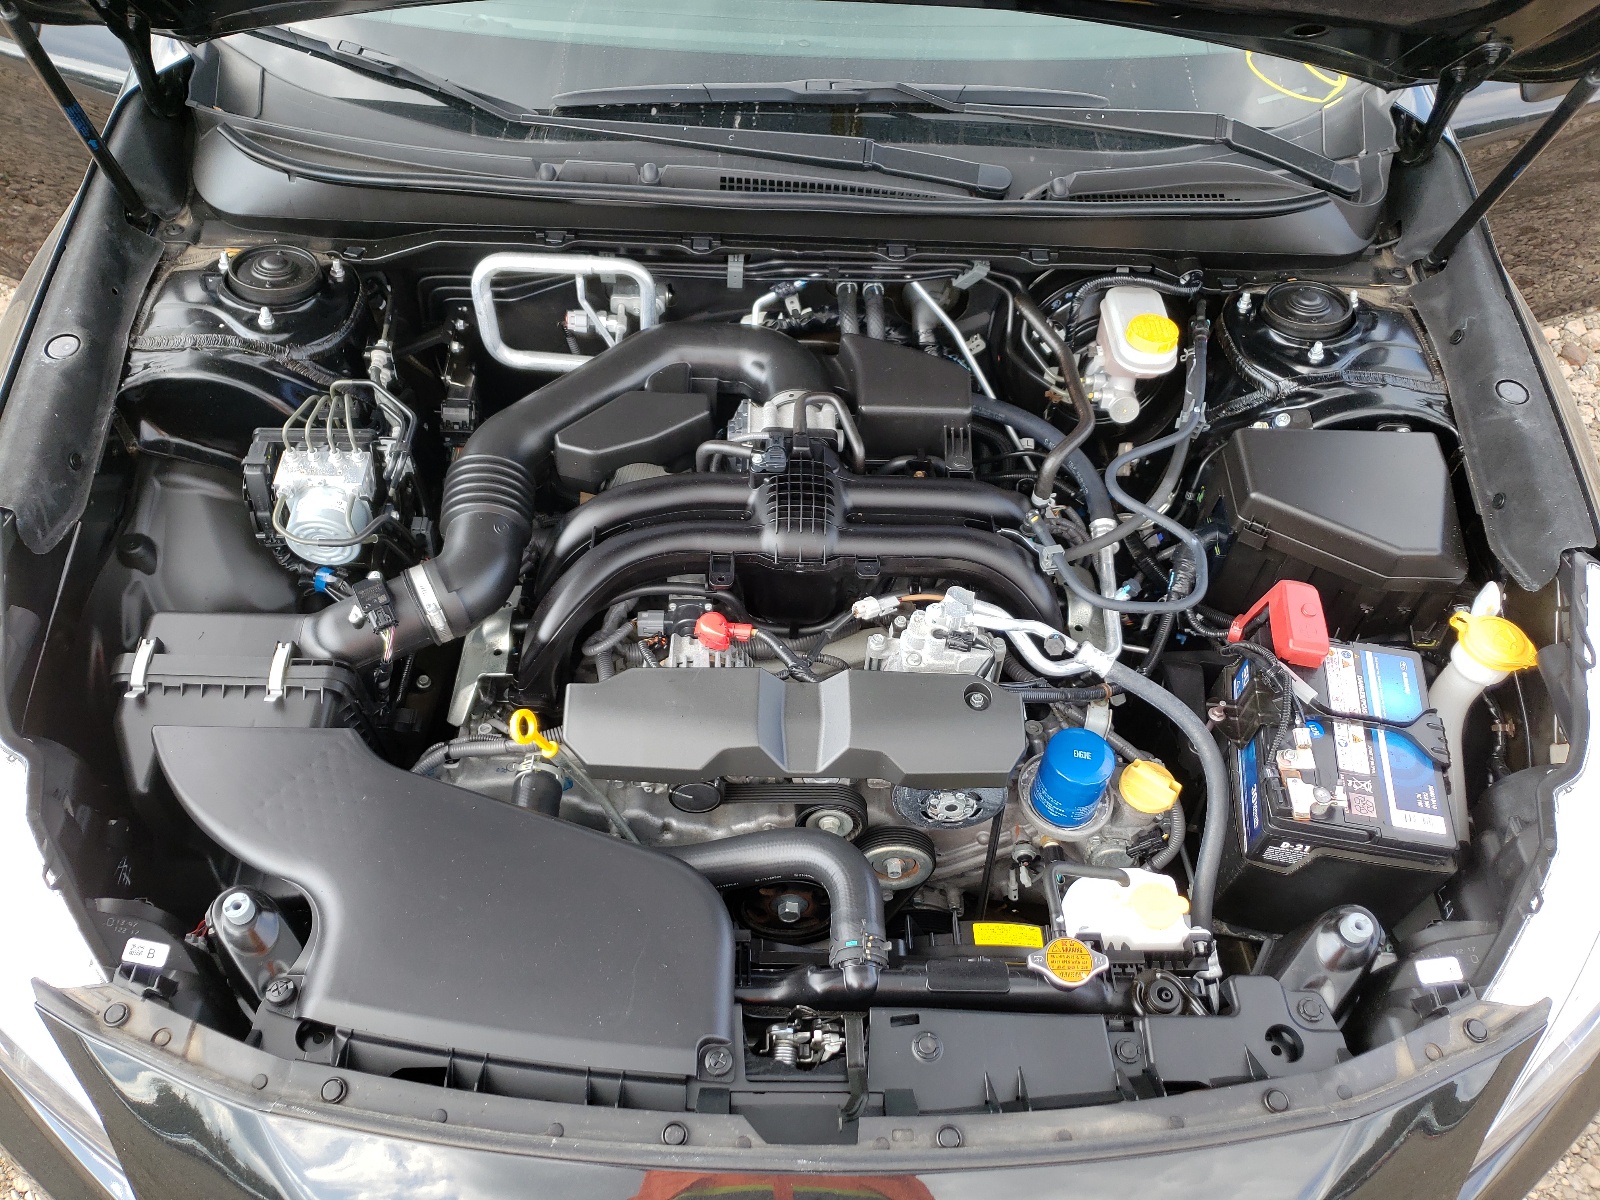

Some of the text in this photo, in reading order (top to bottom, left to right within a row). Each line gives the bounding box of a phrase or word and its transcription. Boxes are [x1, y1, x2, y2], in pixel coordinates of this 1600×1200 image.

[1073, 749, 1092, 760] ENGINE
[1280, 841, 1311, 852] D-21
[146, 948, 156, 959] B
